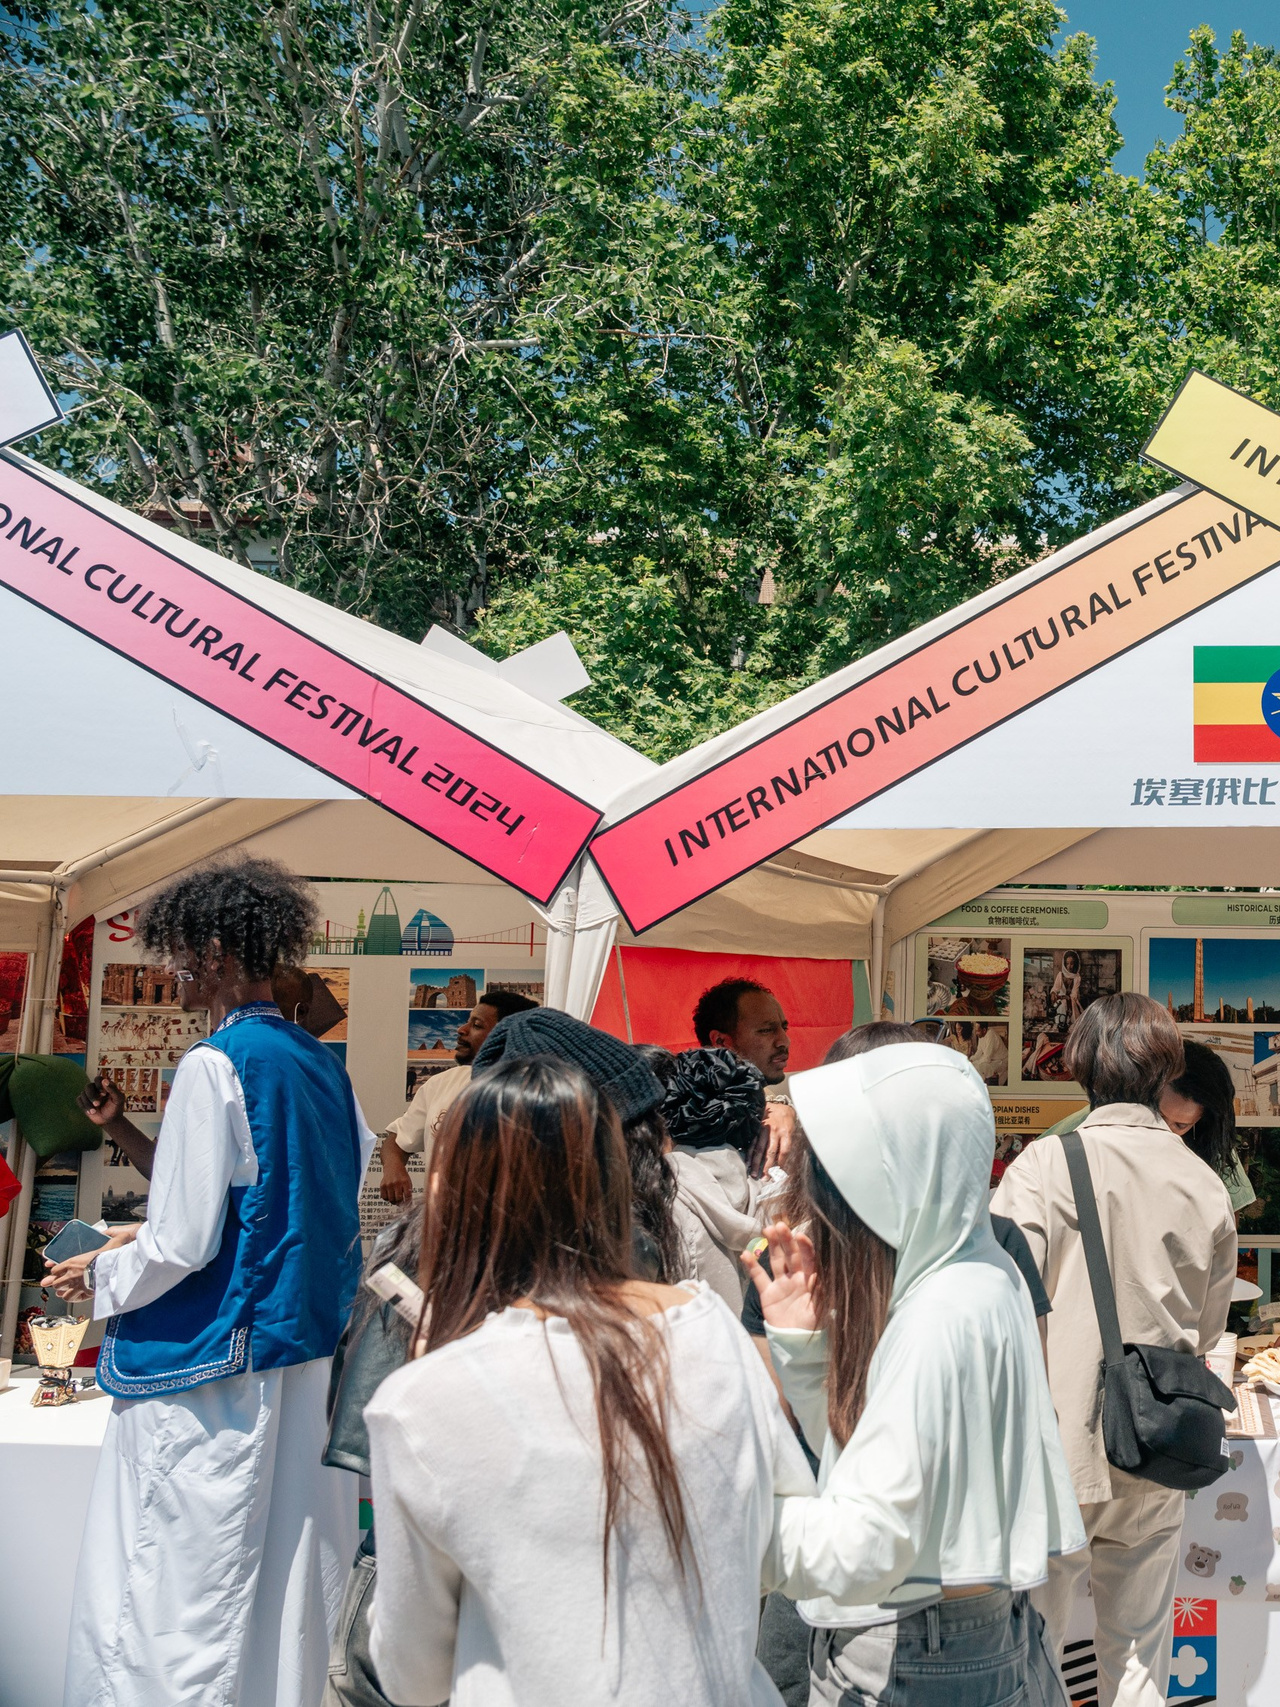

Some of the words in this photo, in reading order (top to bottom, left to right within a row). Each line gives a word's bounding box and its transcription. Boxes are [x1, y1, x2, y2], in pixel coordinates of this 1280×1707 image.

[85, 564, 263, 683] CULTURAL
[263, 668, 420, 776] FESTIVAL
[422, 763, 526, 837] 2024
[664, 687, 951, 867] INTERNATIONAL
[953, 583, 1132, 697] CULTURAL
[1133, 513, 1268, 597] FESTIVA
[961, 905, 982, 913] FOOD
[991, 906, 1019, 914] COFFEE
[1020, 907, 1070, 915] CEREMONIES.
[1227, 904, 1273, 912] HISTORICAL
